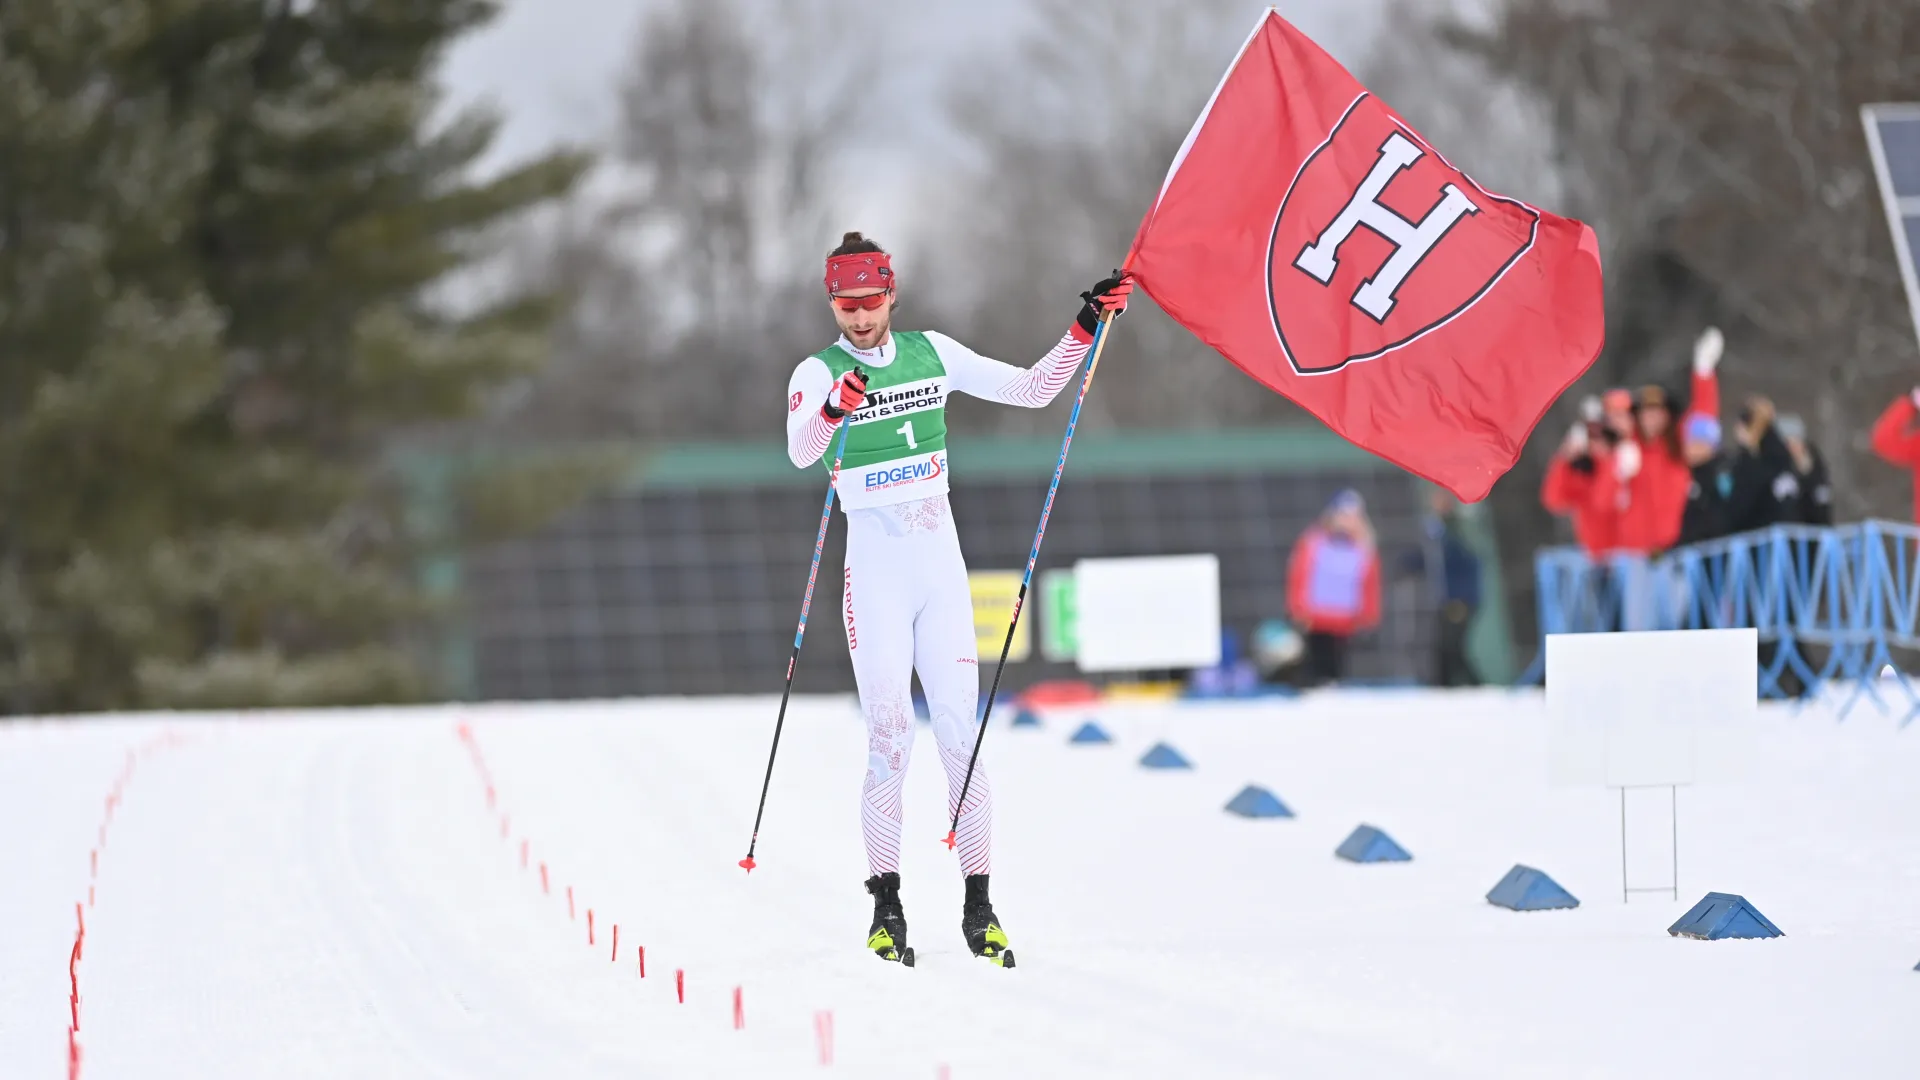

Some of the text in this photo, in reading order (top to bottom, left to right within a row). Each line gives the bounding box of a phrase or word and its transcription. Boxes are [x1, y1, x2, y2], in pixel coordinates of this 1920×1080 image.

[1292, 129, 1483, 325] H
[857, 271, 868, 282] H
[790, 393, 801, 410] H
[849, 396, 944, 423] SKI & SPORT
[855, 382, 942, 411] Skinner's
[896, 420, 918, 450] 1
[865, 453, 946, 488] EDGEWISE
[844, 566, 857, 650] HARVARD
